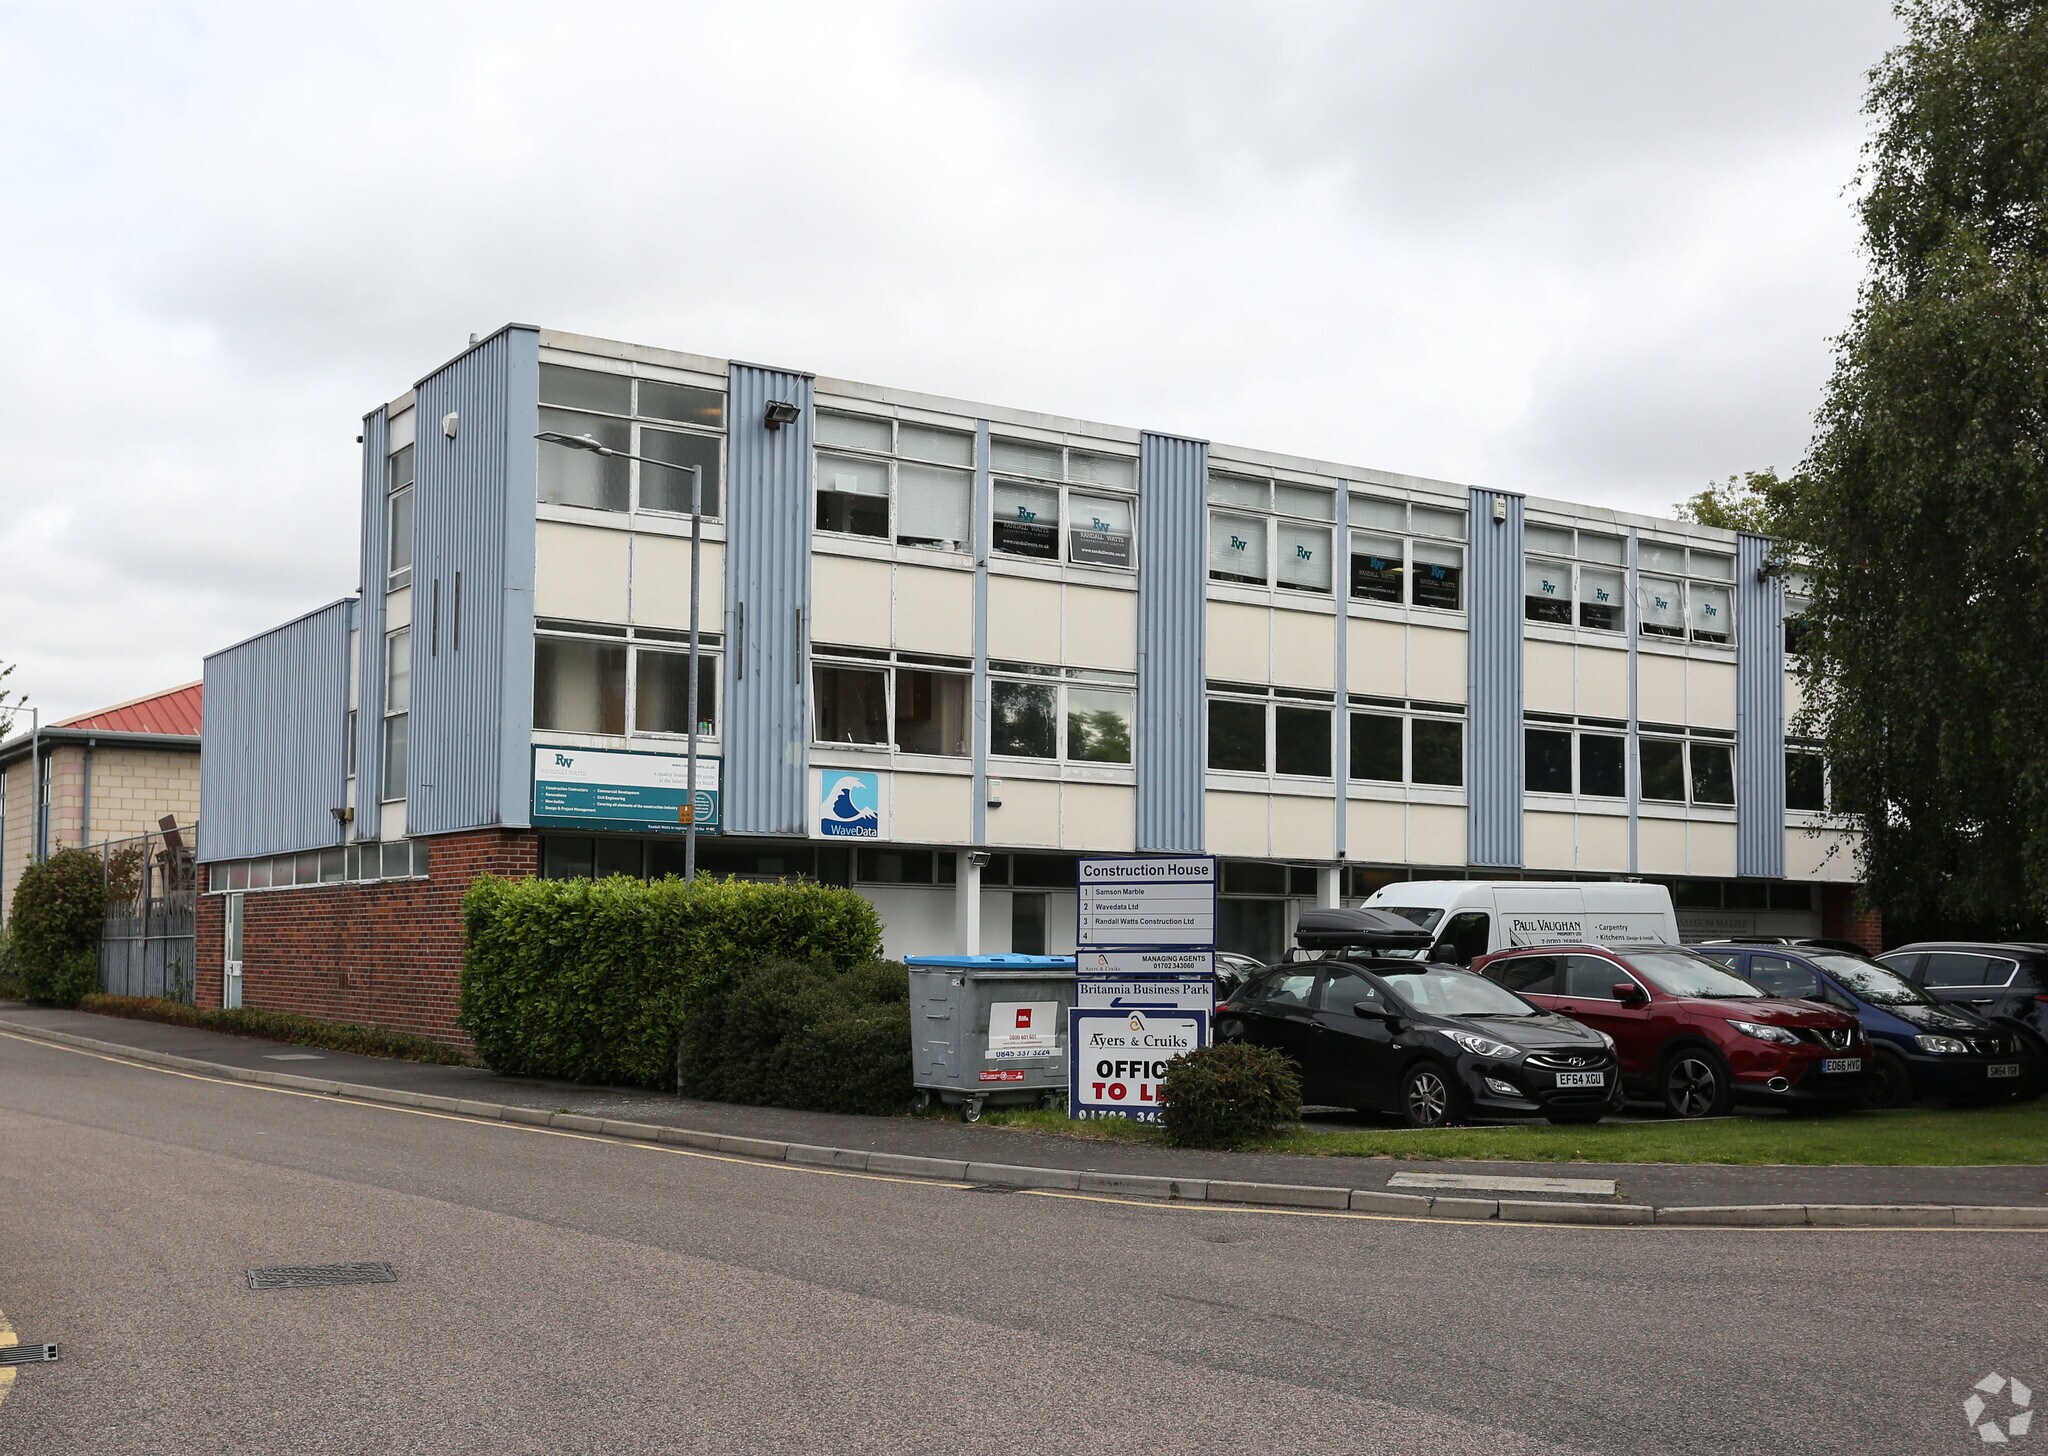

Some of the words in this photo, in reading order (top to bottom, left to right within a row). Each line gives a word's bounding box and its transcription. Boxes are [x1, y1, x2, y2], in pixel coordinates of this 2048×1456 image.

[1018, 506, 1036, 523] RW
[1092, 517, 1110, 533] RW
[1080, 532, 1105, 541] RANDALL
[1106, 535, 1125, 543] WATTS
[1230, 536, 1247, 551] RW
[1296, 546, 1312, 561] RW
[1542, 580, 1555, 594] RW
[1596, 588, 1609, 602] RW
[1655, 597, 1668, 610] RW
[1704, 604, 1717, 617] RW
[555, 753, 574, 768] RW
[831, 824, 877, 837] WaveData
[1083, 864, 1165, 877] Construction
[1167, 864, 1209, 876] House
[1083, 903, 1088, 911] 2
[1513, 920, 1537, 931] PAUL
[1537, 920, 1582, 931] VAUGHAN
[1599, 924, 1628, 932] Carpentry
[1080, 984, 1131, 994] Britannia
[1134, 984, 1180, 994] Business
[1183, 984, 1209, 994] Park
[1089, 1035, 1125, 1049] Ayers
[1131, 1037, 1139, 1046] &
[1144, 1035, 1188, 1047] Cruiks
[1096, 1060, 1167, 1079] OFFIC
[1847, 1060, 1860, 1070] HYG
[1560, 1074, 1584, 1085] EF64
[1586, 1074, 1601, 1085] XGU
[1092, 1082, 1127, 1101] TO
[1140, 1083, 1168, 1102] LE
